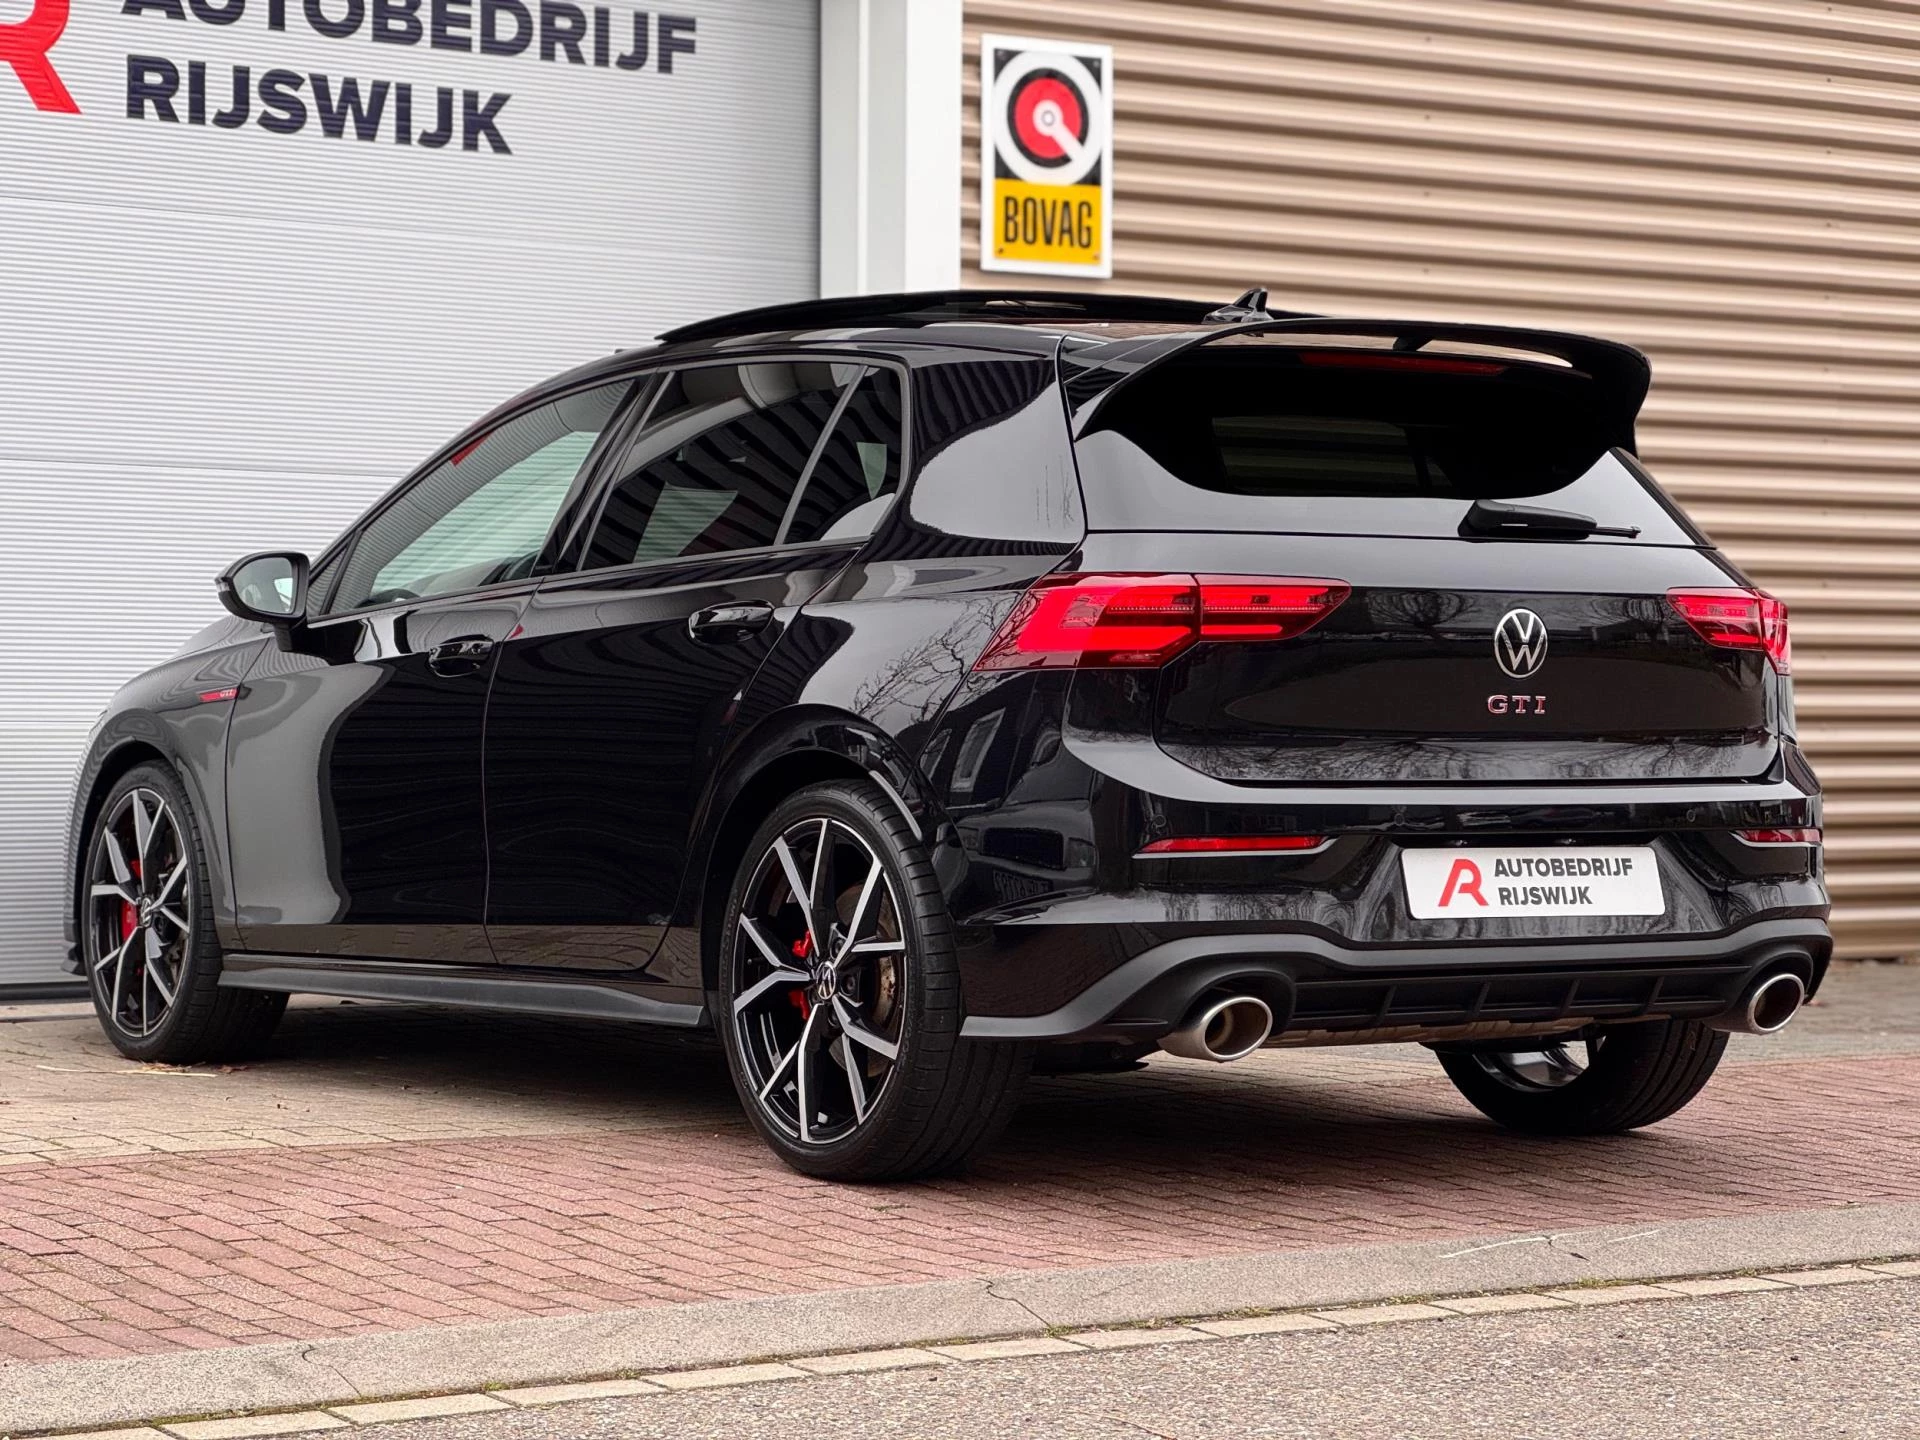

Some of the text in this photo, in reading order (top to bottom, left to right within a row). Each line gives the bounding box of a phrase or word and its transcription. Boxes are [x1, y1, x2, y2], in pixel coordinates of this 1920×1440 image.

[121, 0, 696, 74] OBEDRIJF
[126, 54, 512, 155] RIJSWIJK
[1004, 196, 1092, 249] BOVAG
[1487, 694, 1547, 715] GTI
[1494, 857, 1633, 878] AUTOBEDRIJF
[1498, 886, 1593, 906] RIJSWIJK
